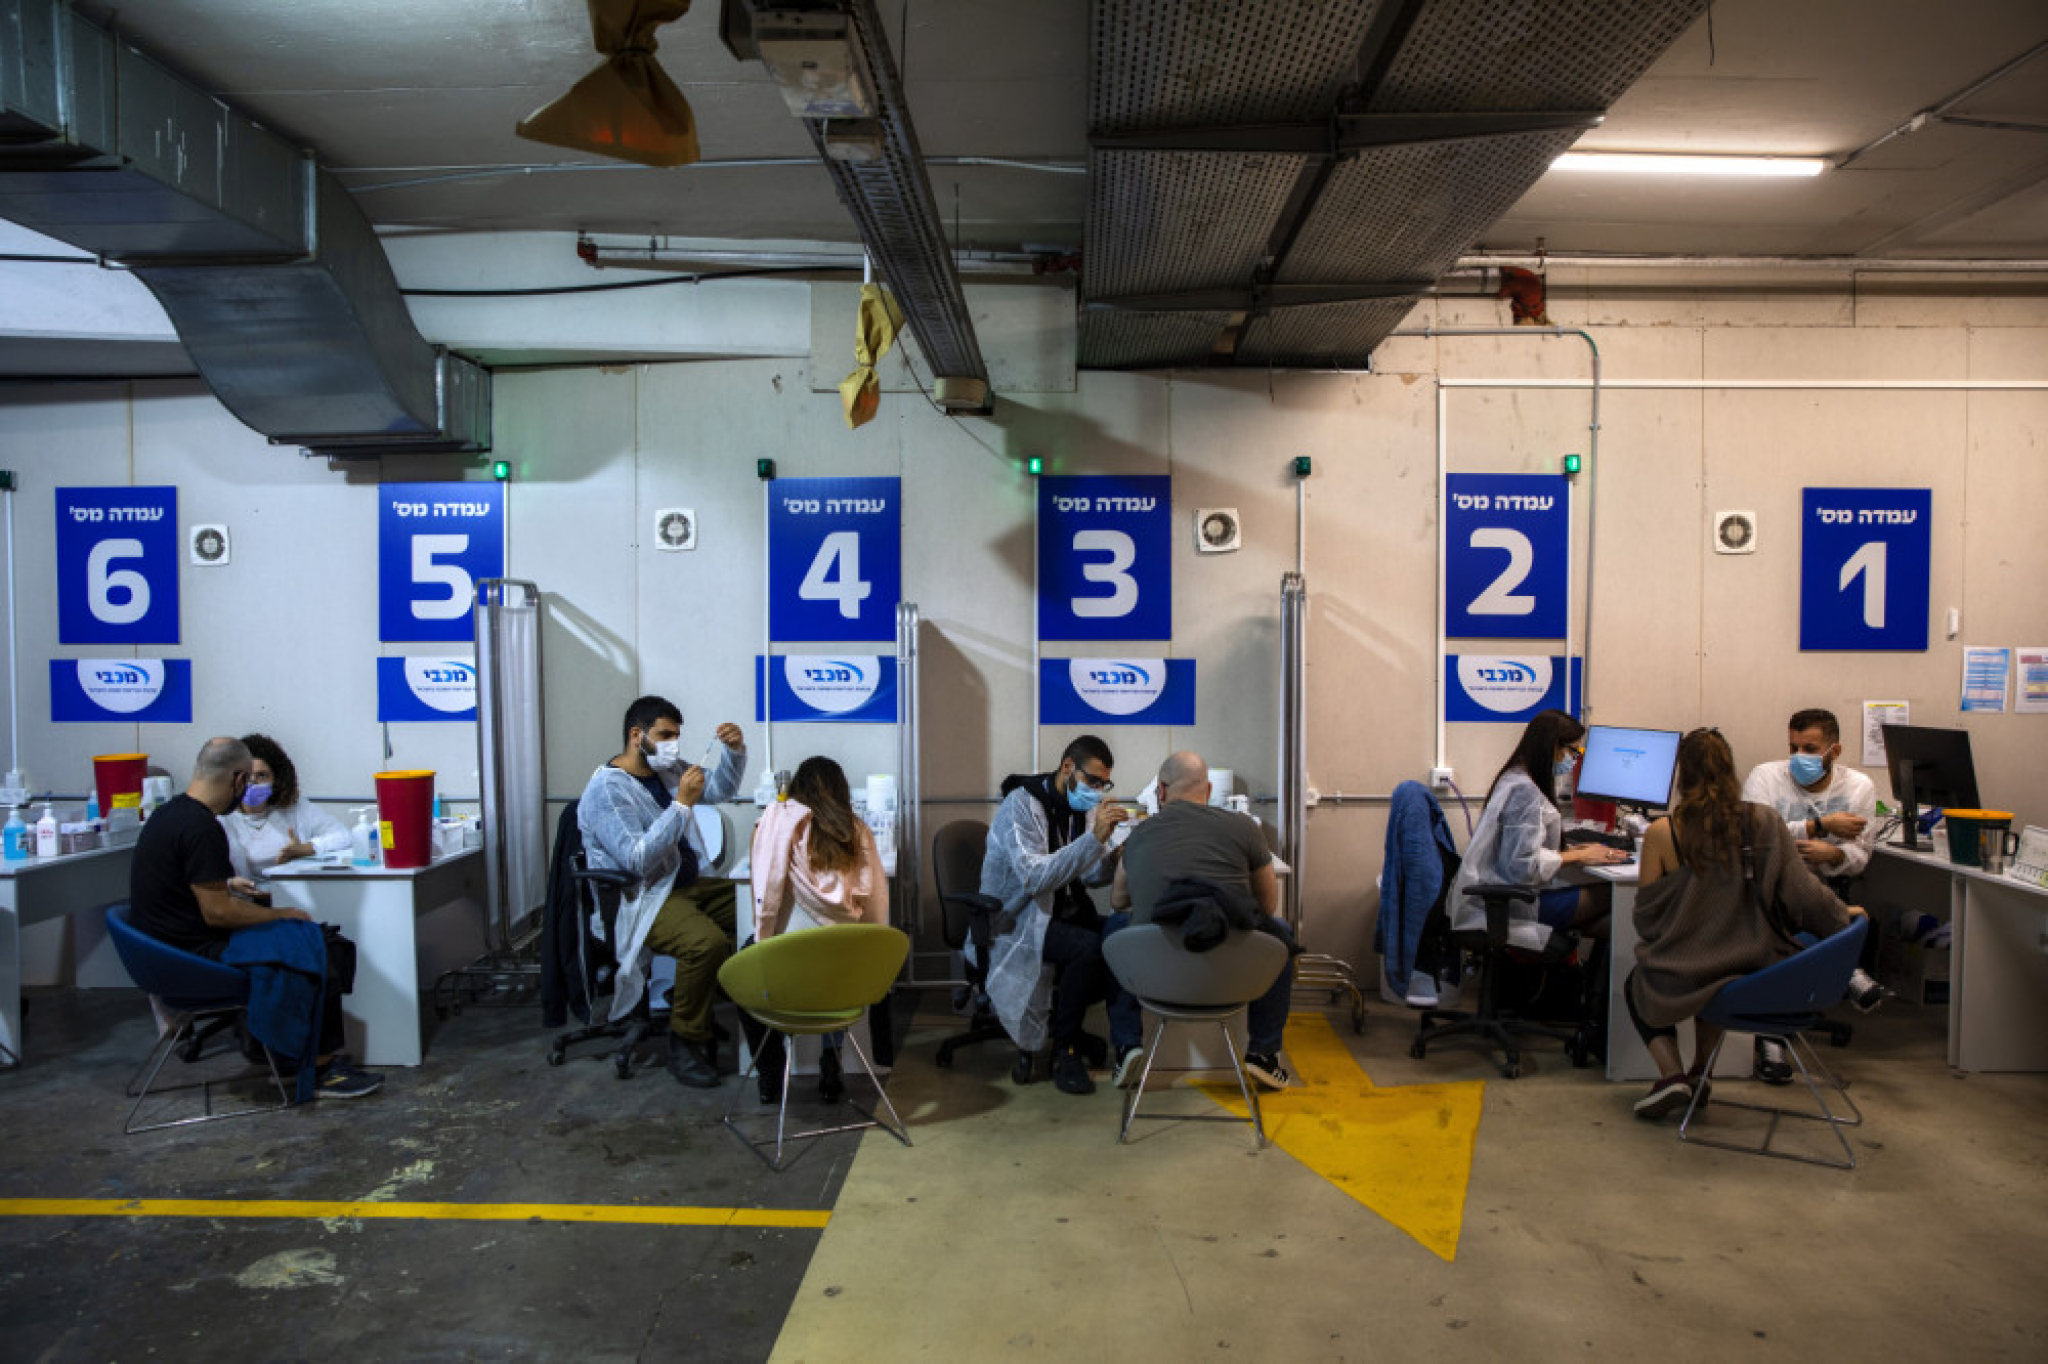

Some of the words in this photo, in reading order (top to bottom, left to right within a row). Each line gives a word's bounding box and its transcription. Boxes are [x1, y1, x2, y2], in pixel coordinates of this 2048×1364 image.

[433, 502, 491, 517] עמדה
[826, 499, 886, 514] עמדה
[1097, 497, 1156, 511] עמדה
[1495, 495, 1554, 511] עמדה
[108, 506, 163, 521] עמדה
[1858, 509, 1918, 524] עמדה
[410, 533, 474, 620] 5
[798, 531, 871, 619] 4
[1071, 530, 1139, 618] 3
[1466, 528, 1535, 615] 2
[87, 538, 150, 624] 6
[1839, 541, 1887, 628] 1
[95, 671, 139, 684] מכבי
[423, 669, 468, 682] מכבי
[804, 669, 850, 682] מכבי
[1089, 671, 1137, 684] מכבי
[1477, 669, 1524, 682] מכבי
